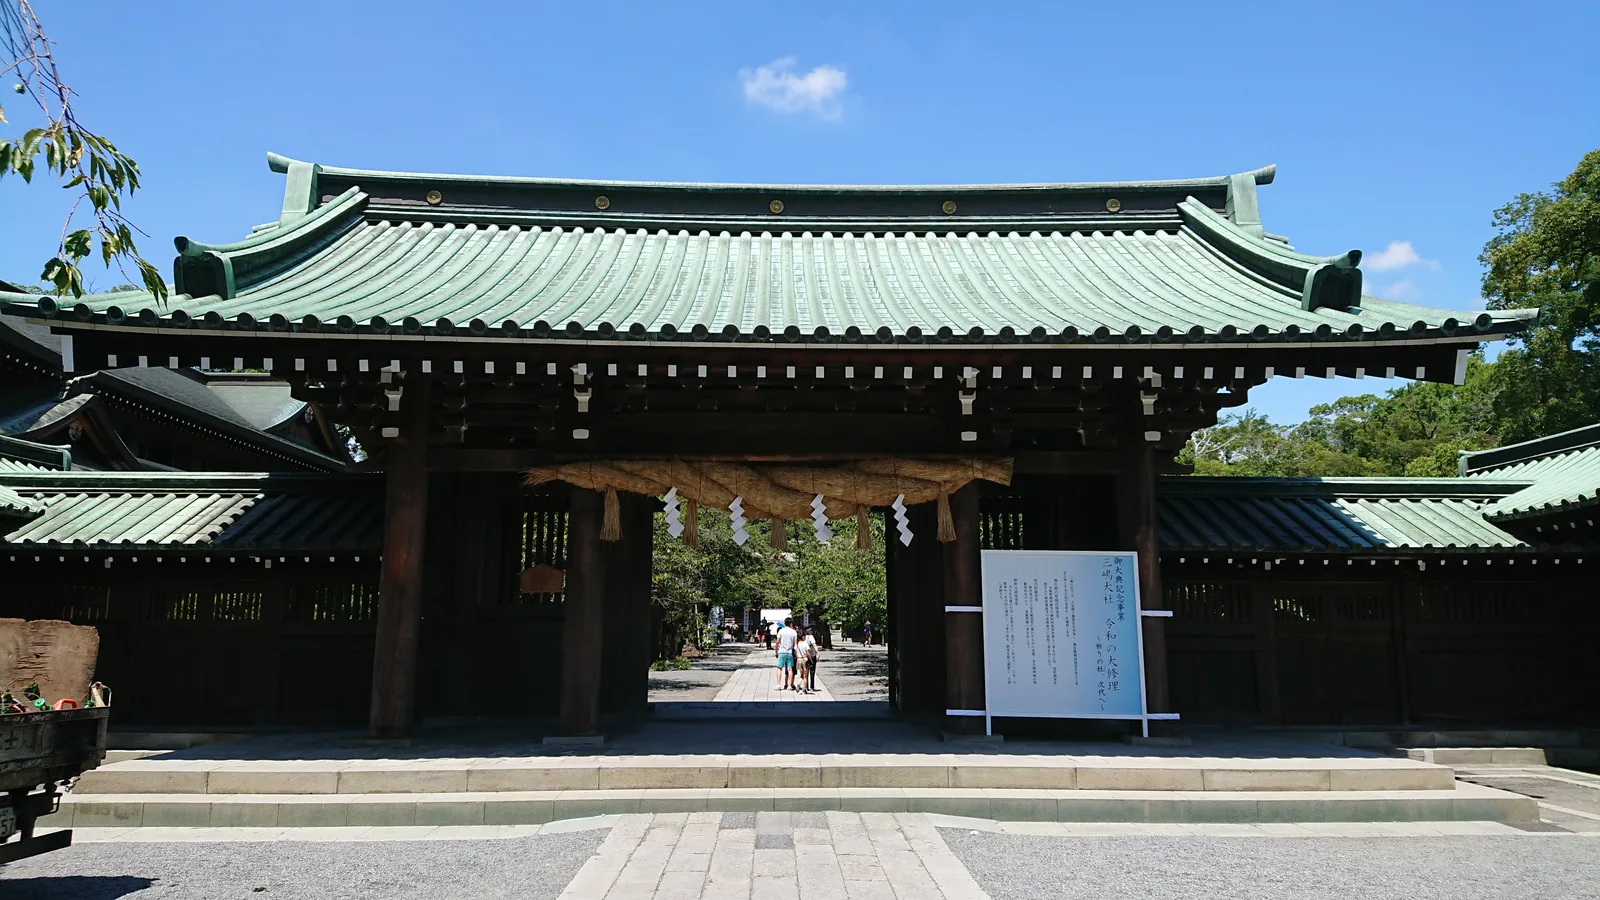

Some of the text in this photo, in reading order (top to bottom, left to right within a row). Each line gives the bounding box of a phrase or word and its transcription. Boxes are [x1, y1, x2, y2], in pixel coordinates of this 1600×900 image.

[1114, 557, 1125, 622] 御大典記念事業
[1105, 618, 1119, 691] 令和の大修理
